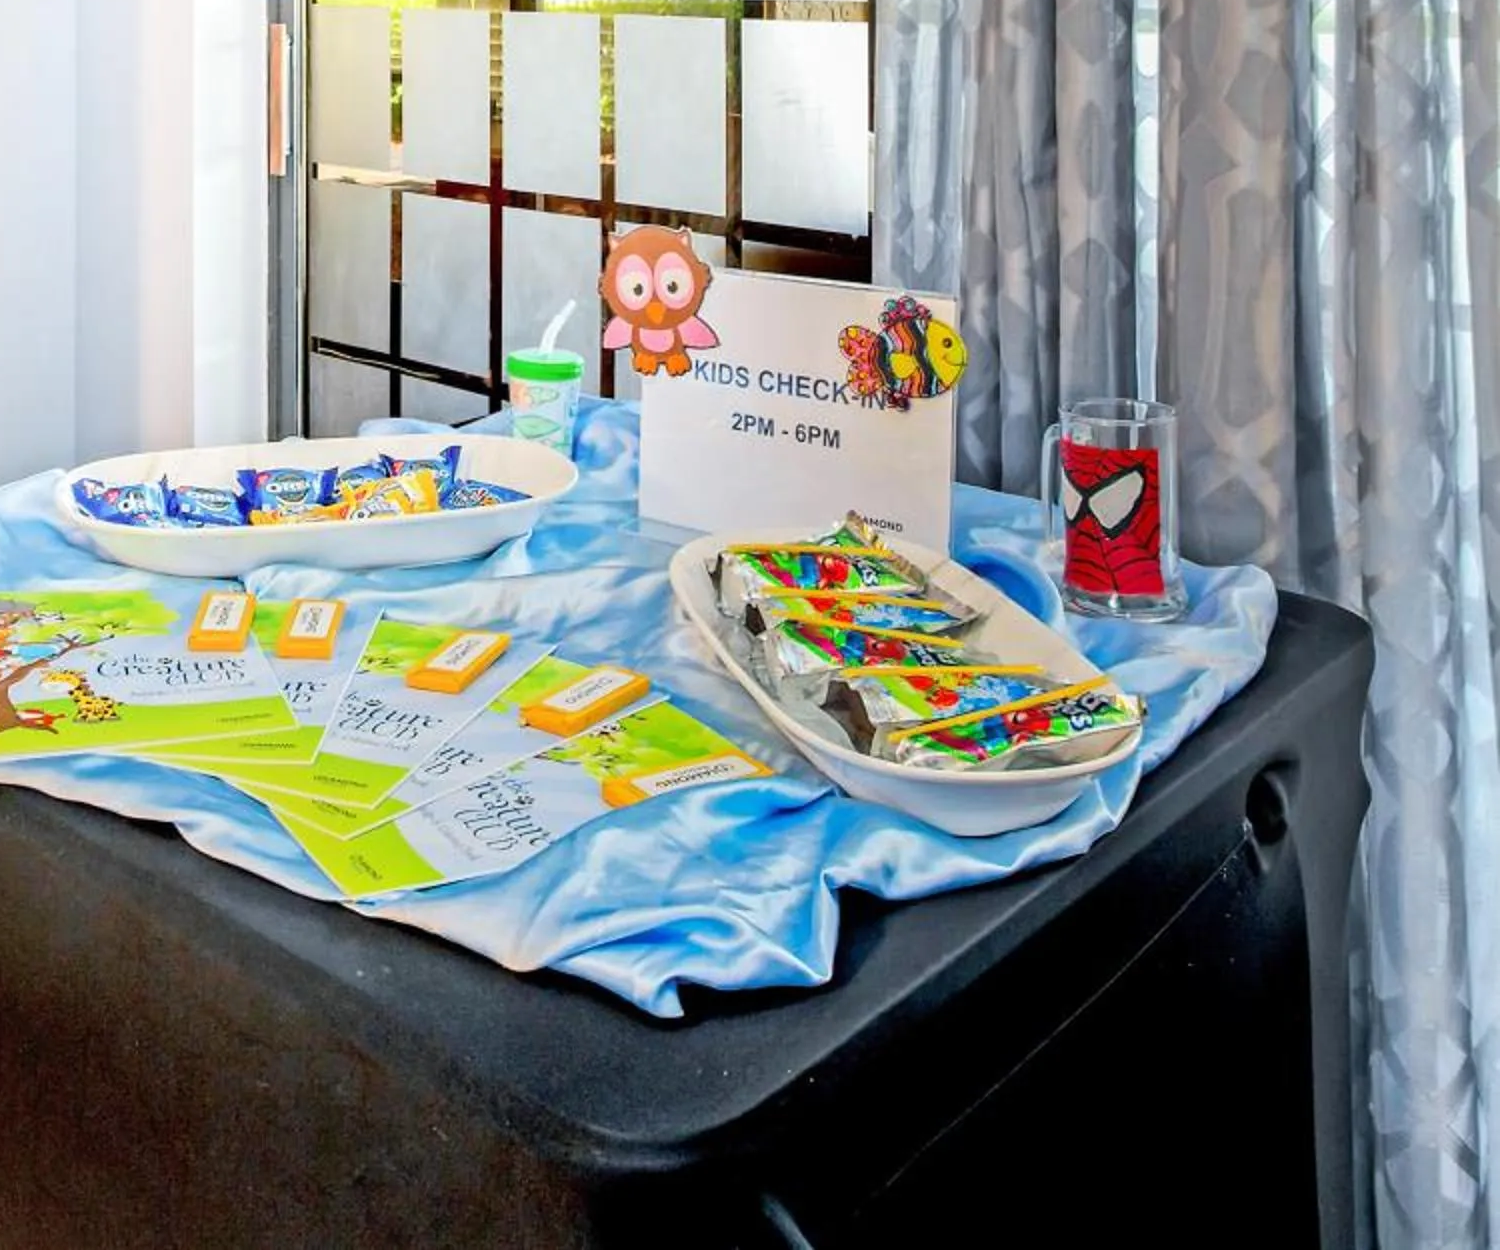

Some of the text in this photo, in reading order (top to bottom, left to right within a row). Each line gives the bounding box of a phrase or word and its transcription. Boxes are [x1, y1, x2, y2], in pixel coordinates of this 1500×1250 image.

[694, 358, 750, 389] KIDS
[731, 412, 775, 438] 2PM
[795, 423, 842, 450] 6PM
[96, 655, 246, 678] Creature
